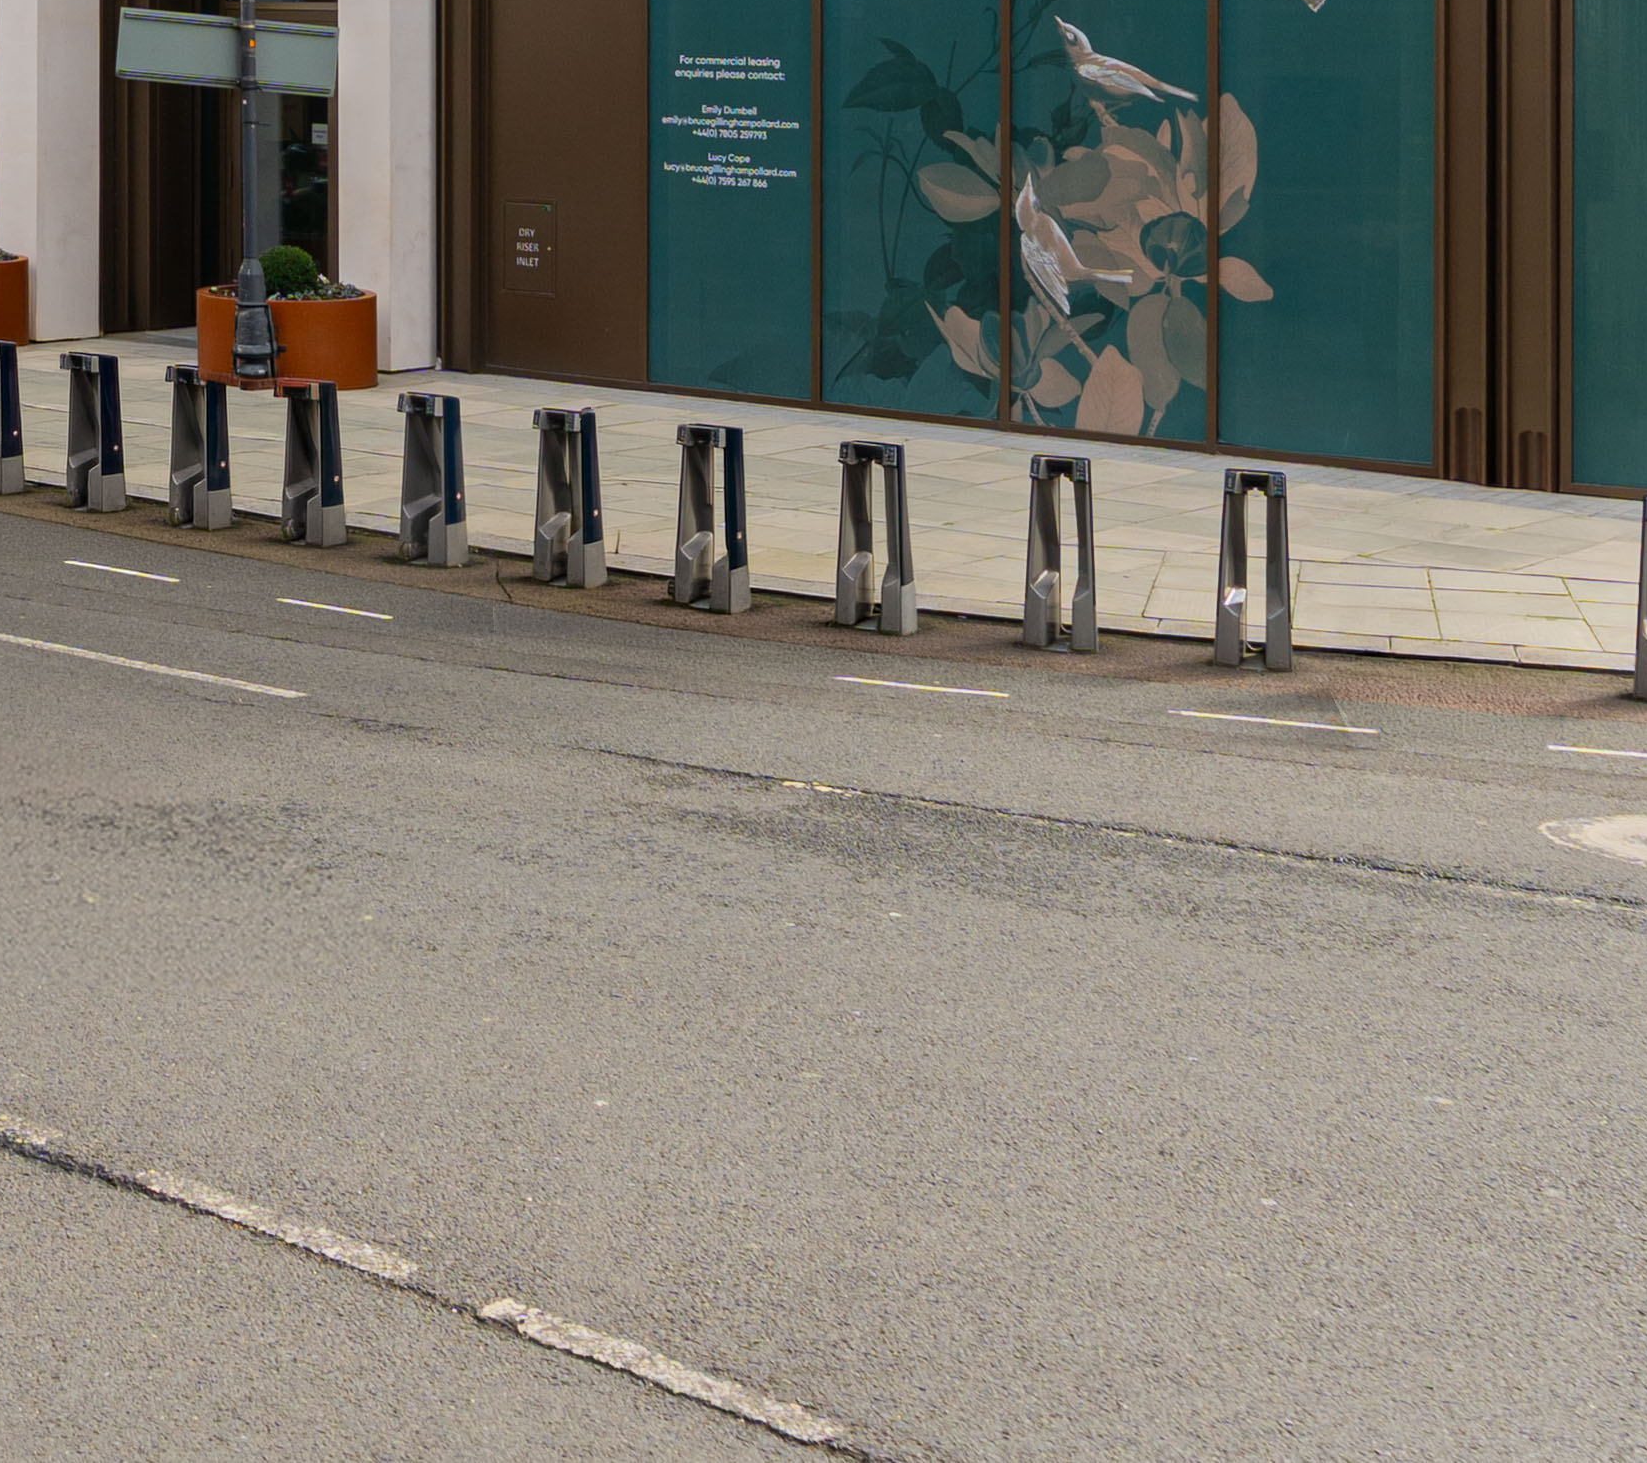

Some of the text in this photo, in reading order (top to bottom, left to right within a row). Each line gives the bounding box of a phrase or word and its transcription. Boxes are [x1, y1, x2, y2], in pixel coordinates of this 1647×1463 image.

[679, 54, 780, 68] For commercial leasing
[674, 68, 786, 81] enquiries please contact:
[701, 104, 722, 115] Emily
[707, 152, 751, 163] Lucy Cope
[518, 227, 536, 238] DRY
[516, 242, 540, 253] RISER
[516, 256, 540, 267] INLET
